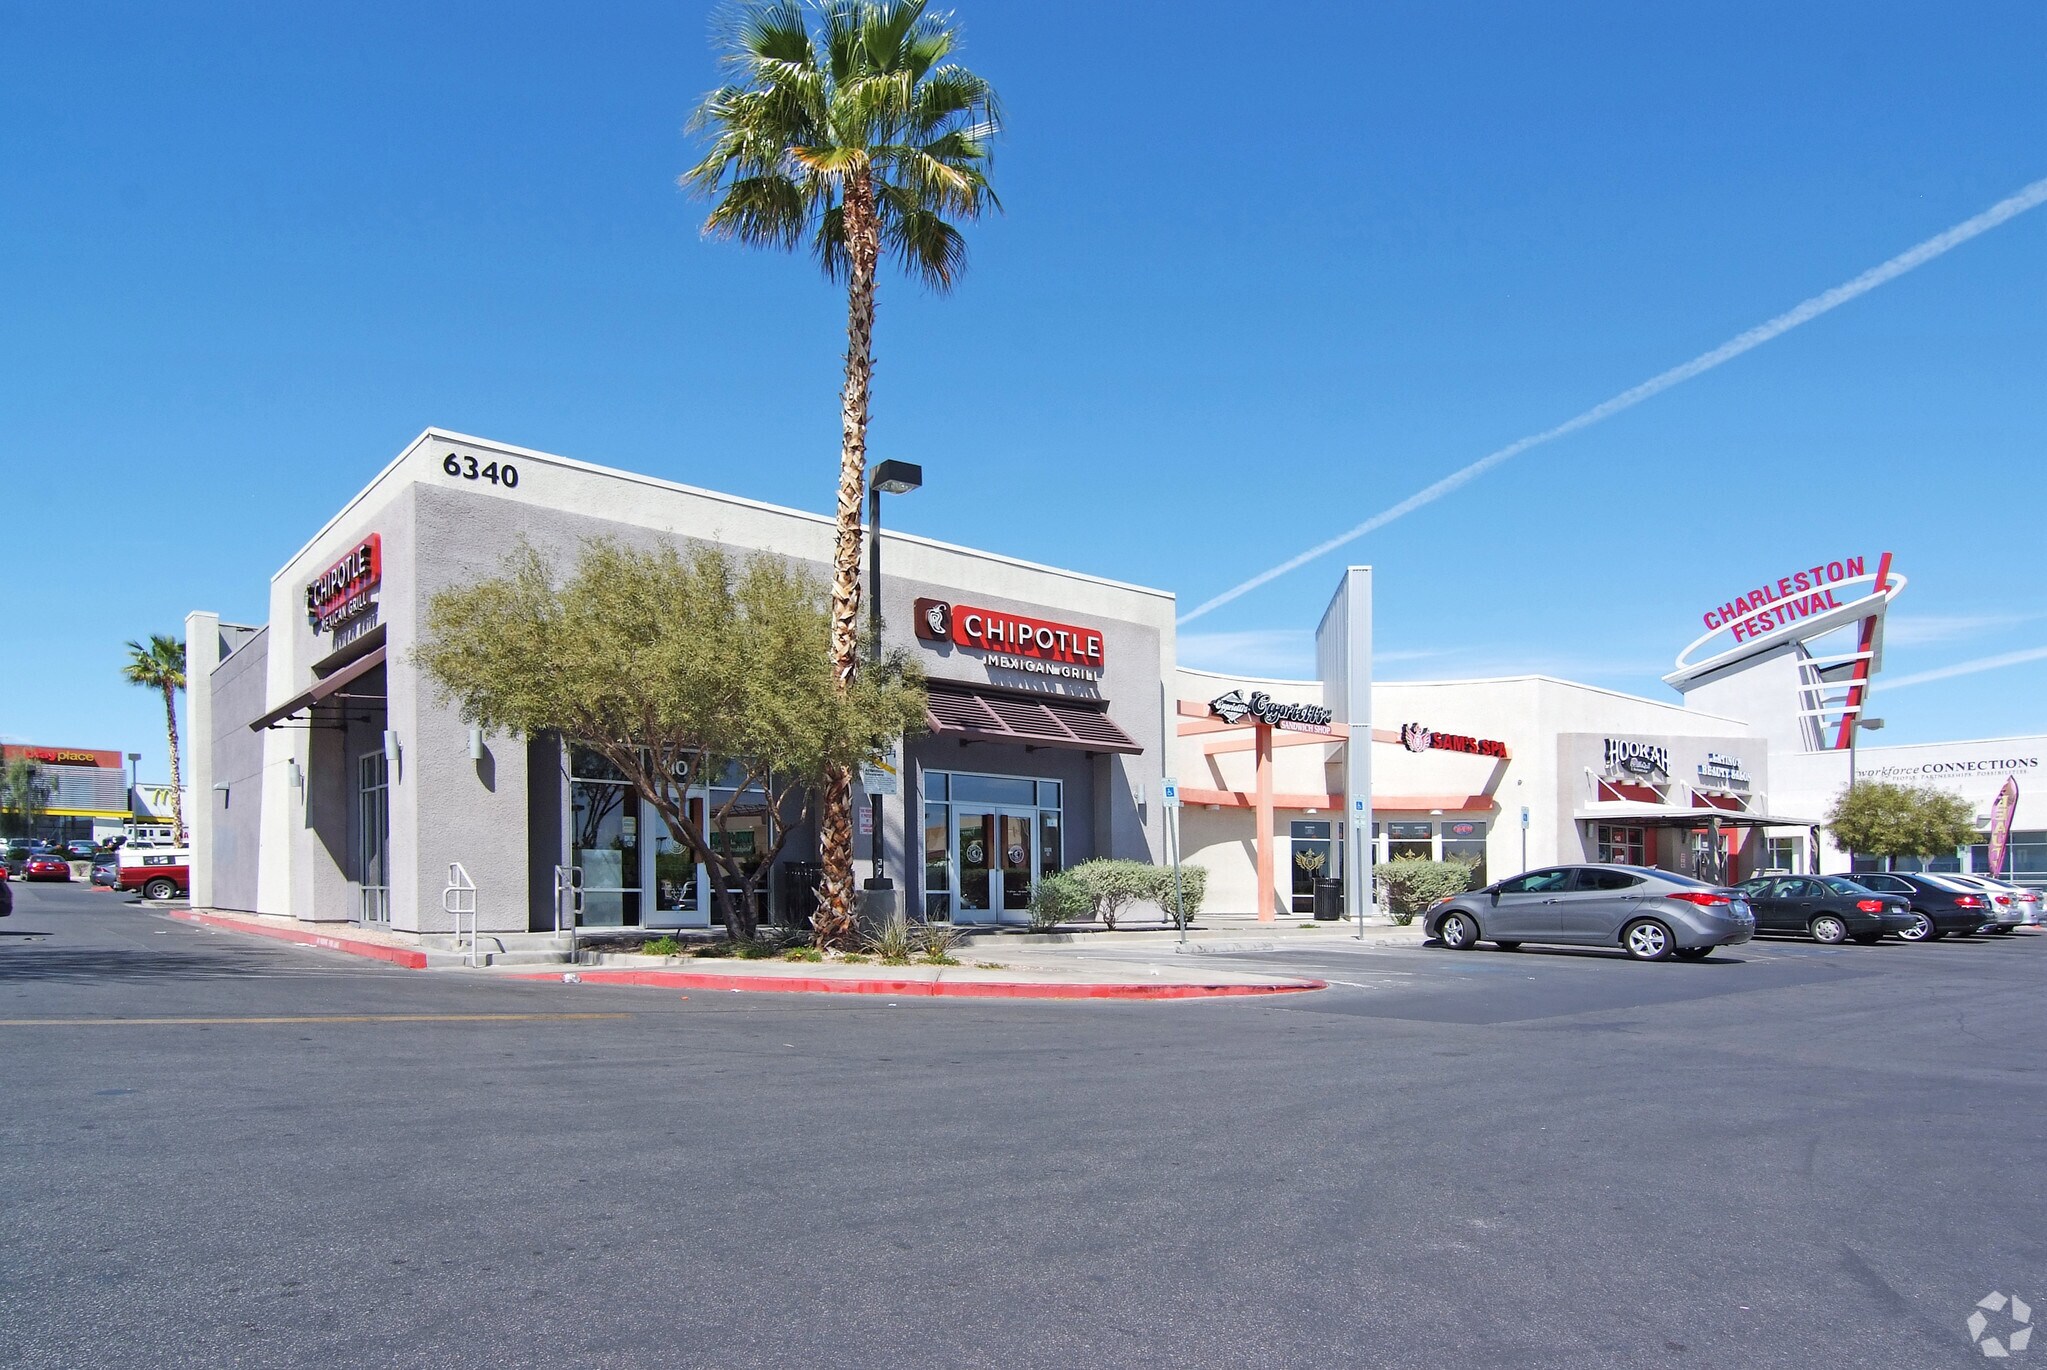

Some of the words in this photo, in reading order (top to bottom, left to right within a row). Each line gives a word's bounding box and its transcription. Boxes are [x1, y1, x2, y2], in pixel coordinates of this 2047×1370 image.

[443, 452, 519, 488] 6340
[313, 543, 369, 606] CHIPOTLE
[348, 592, 368, 615] GRILL
[1703, 556, 1865, 631] CHARLESTON
[1731, 588, 1843, 643] FESTIVAL
[964, 614, 1101, 658] CHIPOTLE
[987, 653, 1054, 676] MEXICAN
[1061, 665, 1102, 682] GRILL
[1280, 720, 1314, 733] SANDWICH
[1314, 724, 1332, 735] SHOP
[1431, 731, 1479, 755] SAM'S
[1480, 739, 1508, 758] SPA
[1607, 738, 1670, 778] HOOKAH
[1856, 765, 1920, 779] workforce
[1922, 757, 2039, 775] CONNECTIONS
